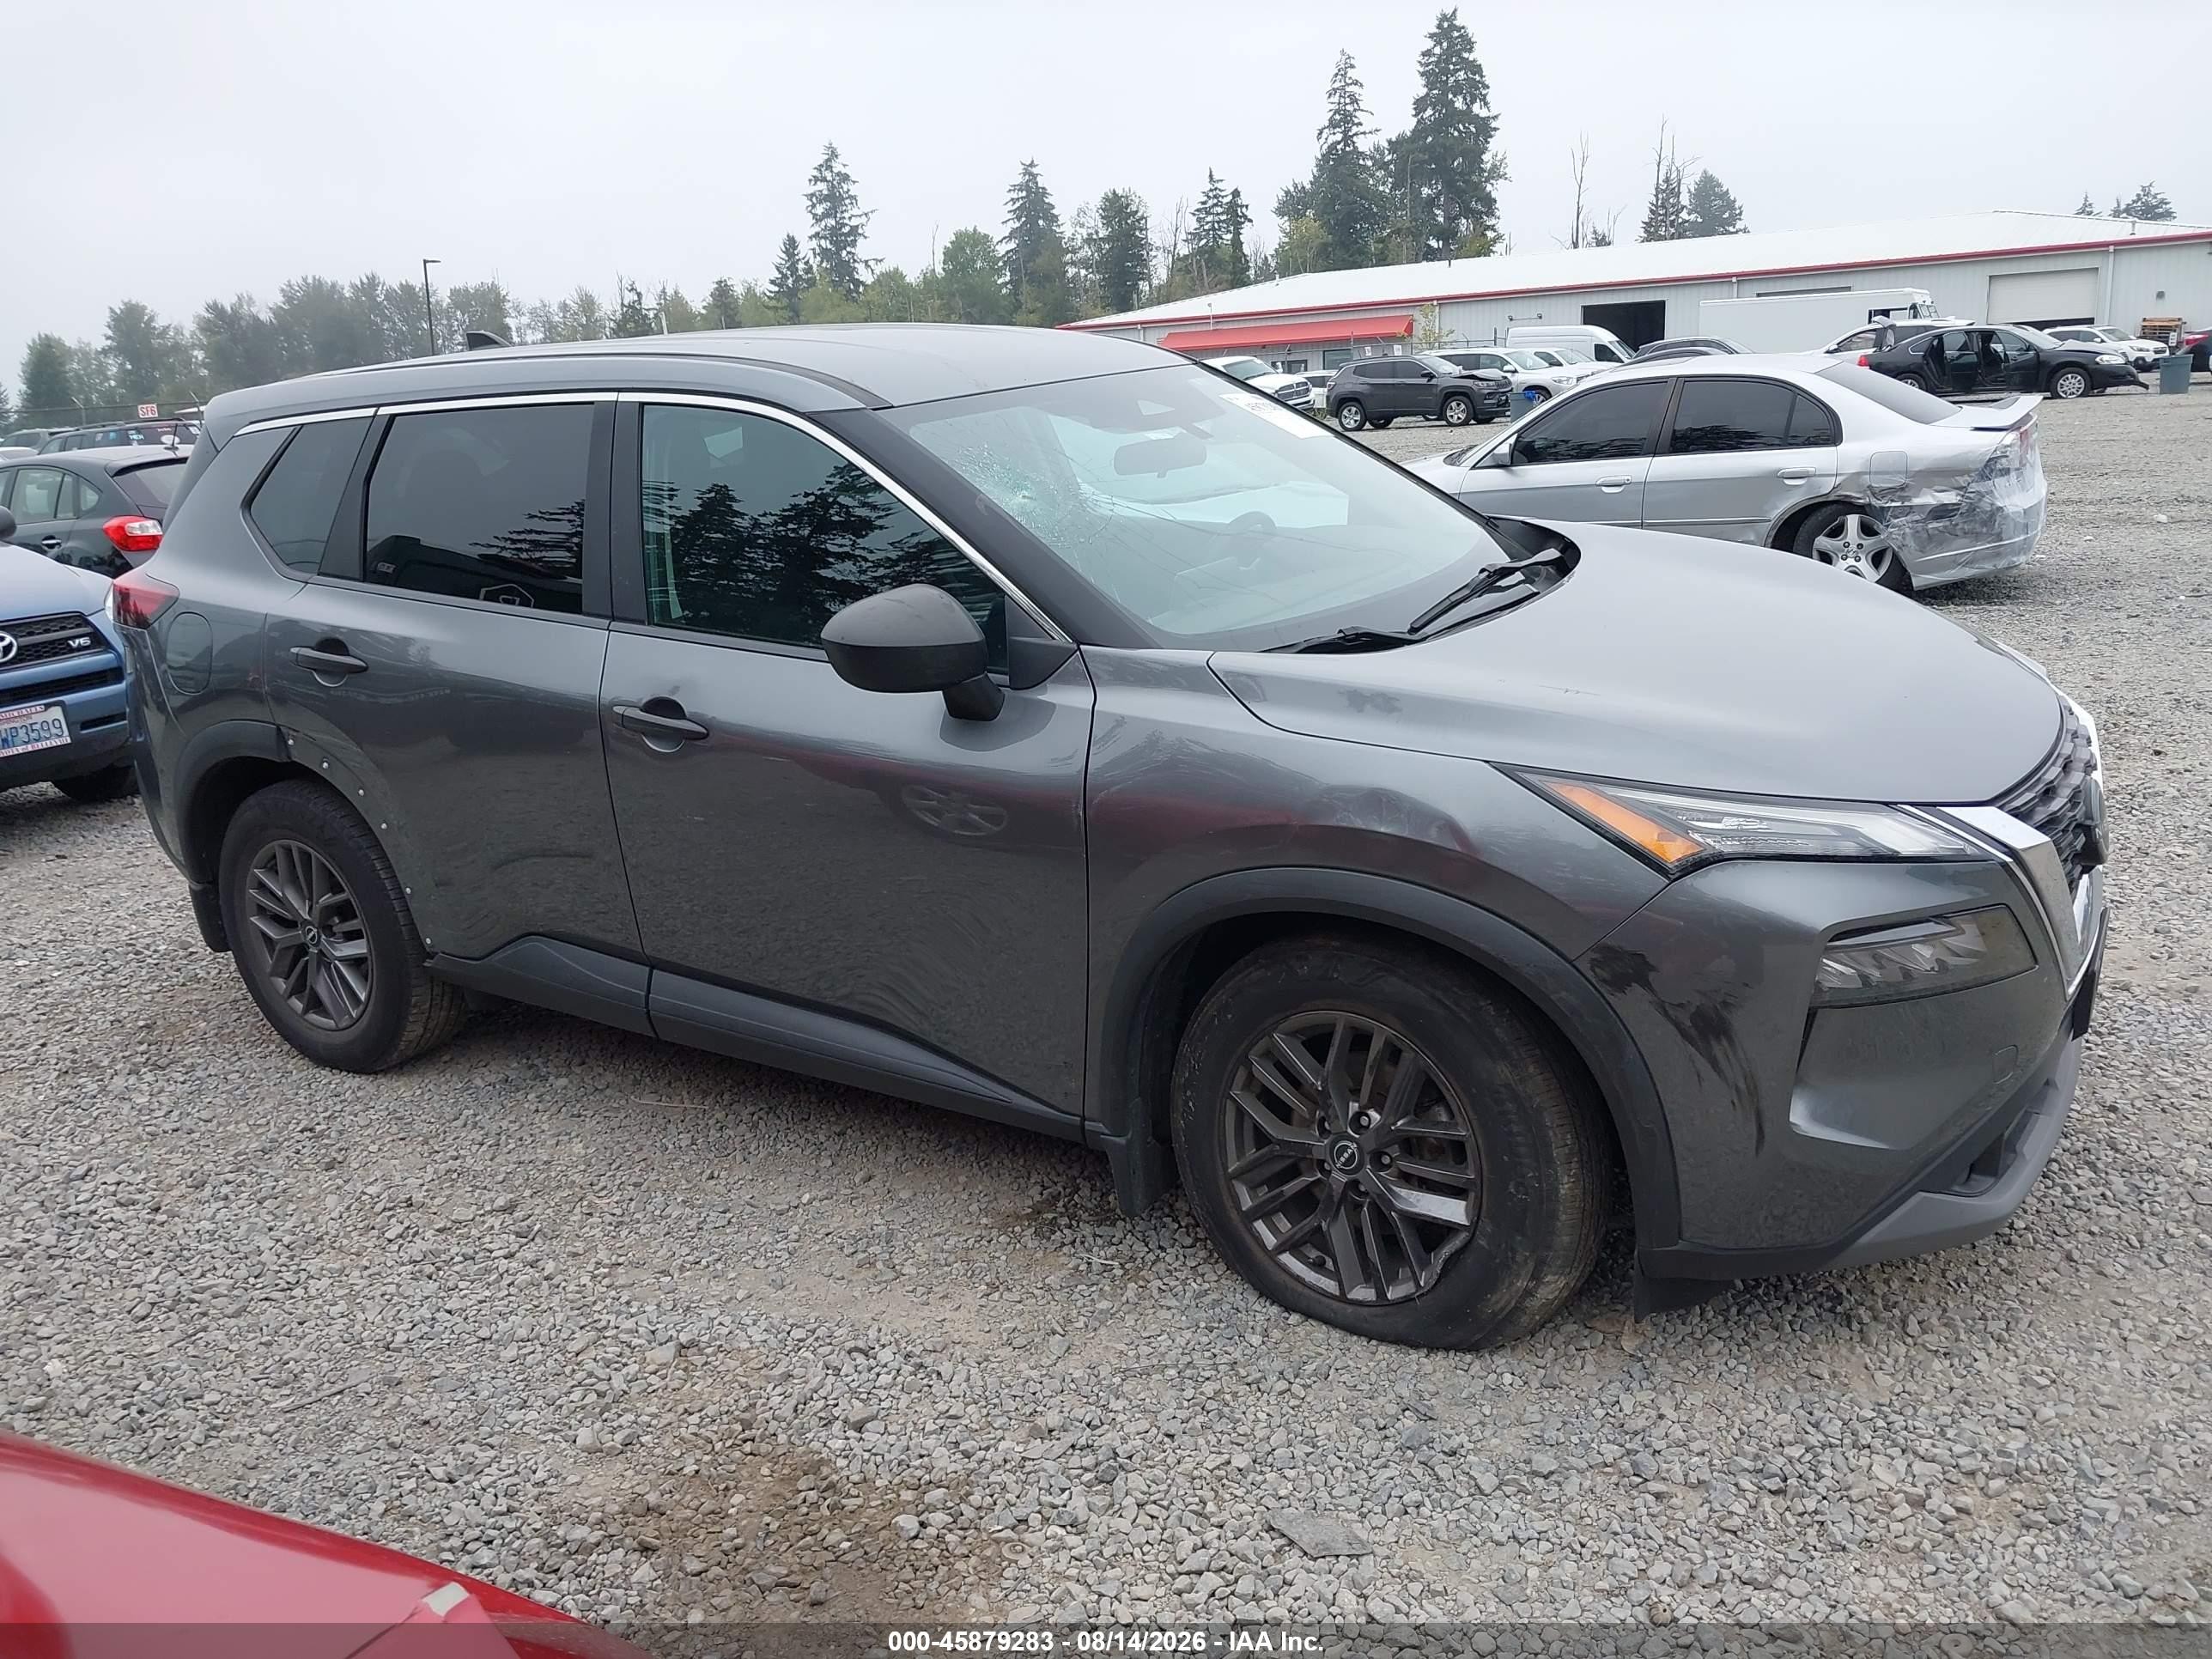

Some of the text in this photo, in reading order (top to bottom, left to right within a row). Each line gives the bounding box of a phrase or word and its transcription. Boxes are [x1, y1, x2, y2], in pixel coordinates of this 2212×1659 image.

[139, 406, 156, 417] SF6
[67, 636, 91, 647] V6
[1335, 1141, 1358, 1169] NISSAN
